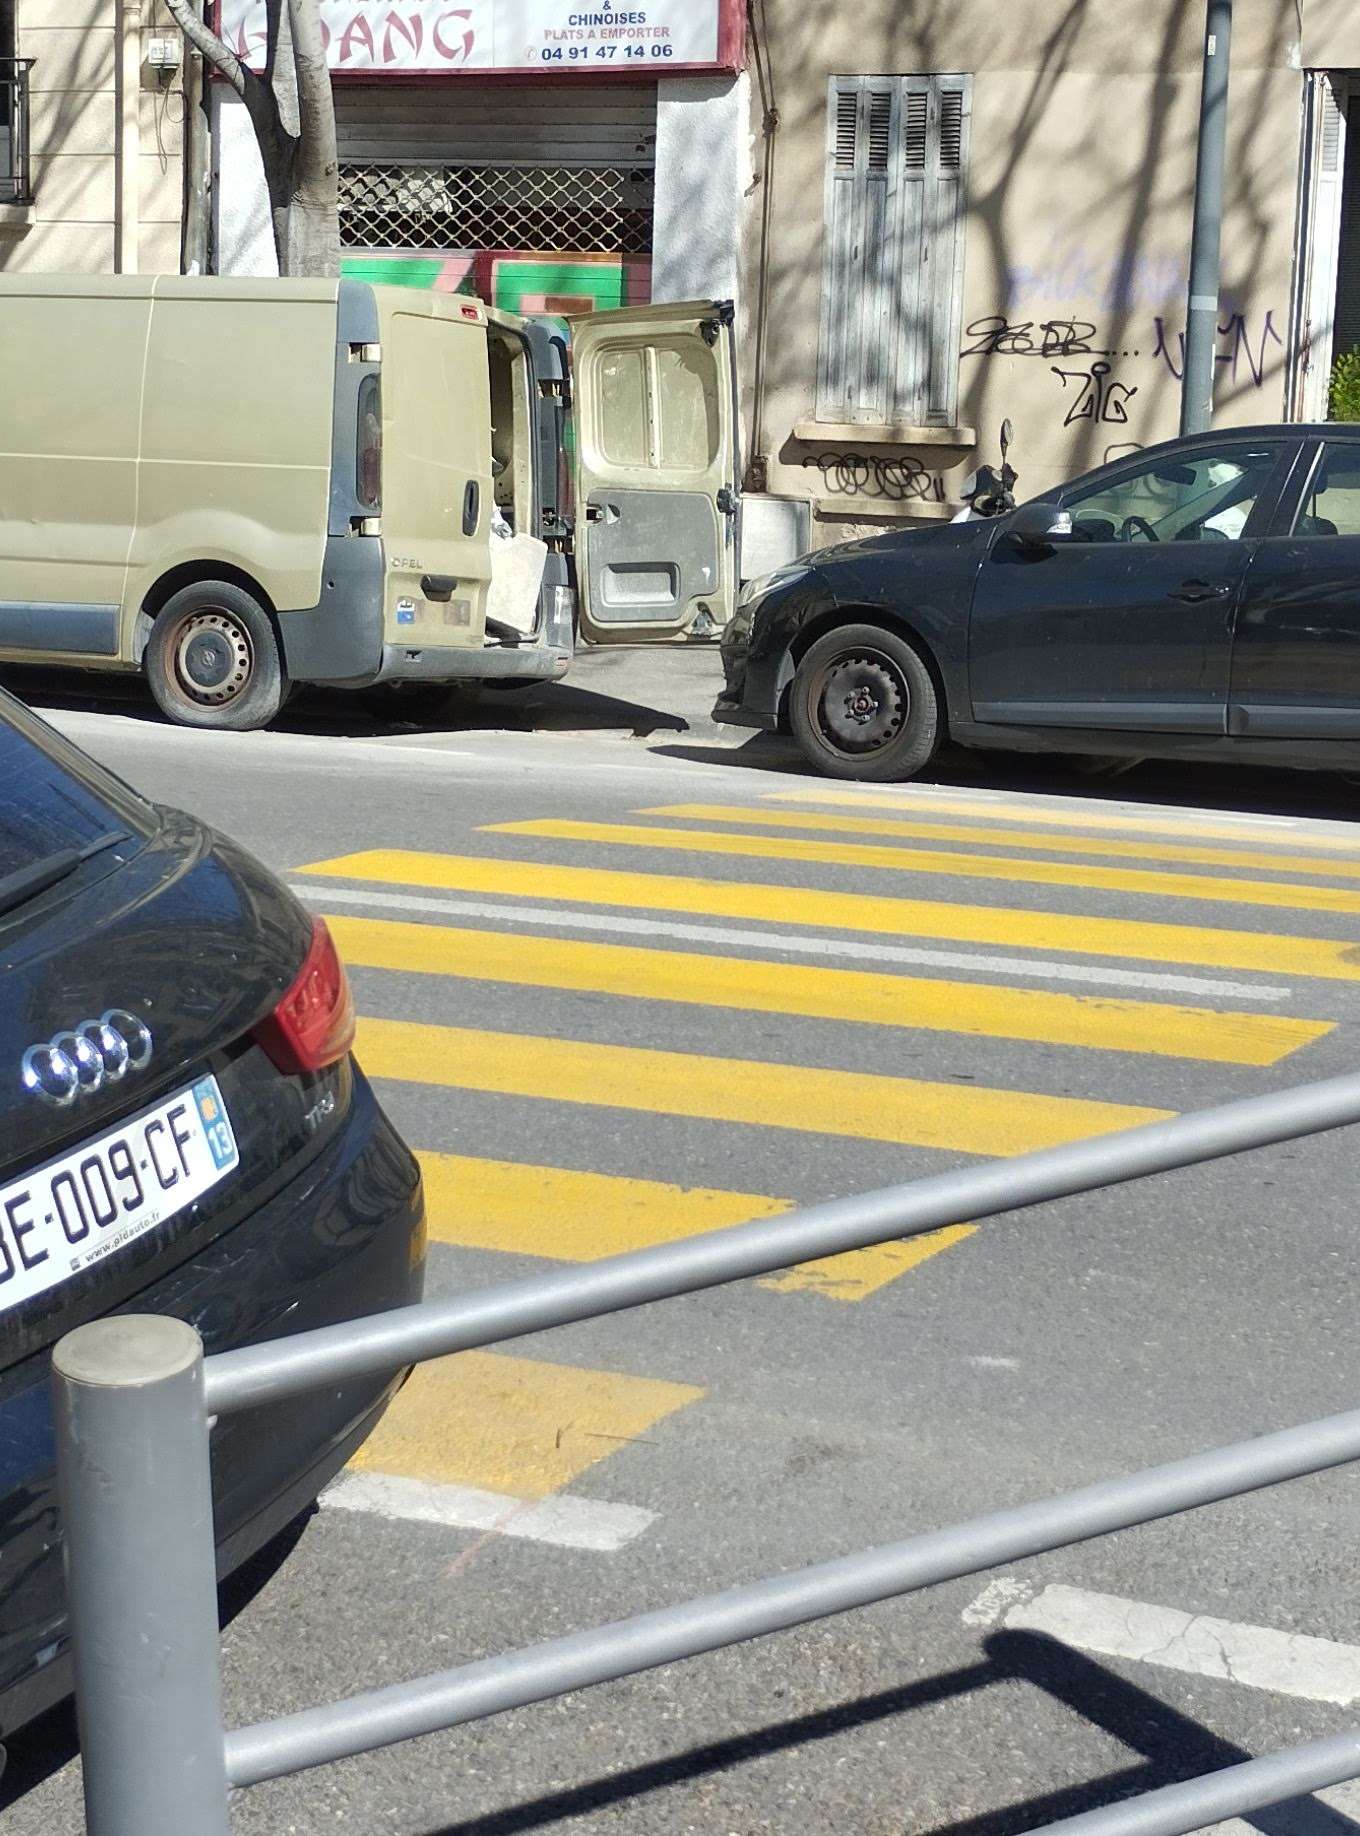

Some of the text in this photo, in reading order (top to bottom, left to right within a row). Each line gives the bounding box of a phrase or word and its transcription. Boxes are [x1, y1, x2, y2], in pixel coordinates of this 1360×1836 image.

[568, 12, 647, 26] CHINOISES
[544, 29, 584, 41] PLATS
[600, 26, 671, 39] EMPORTER
[541, 44, 673, 61] 04 91 47 14 06
[391, 557, 423, 570] OPEL
[207, 1120, 233, 1160] 13
